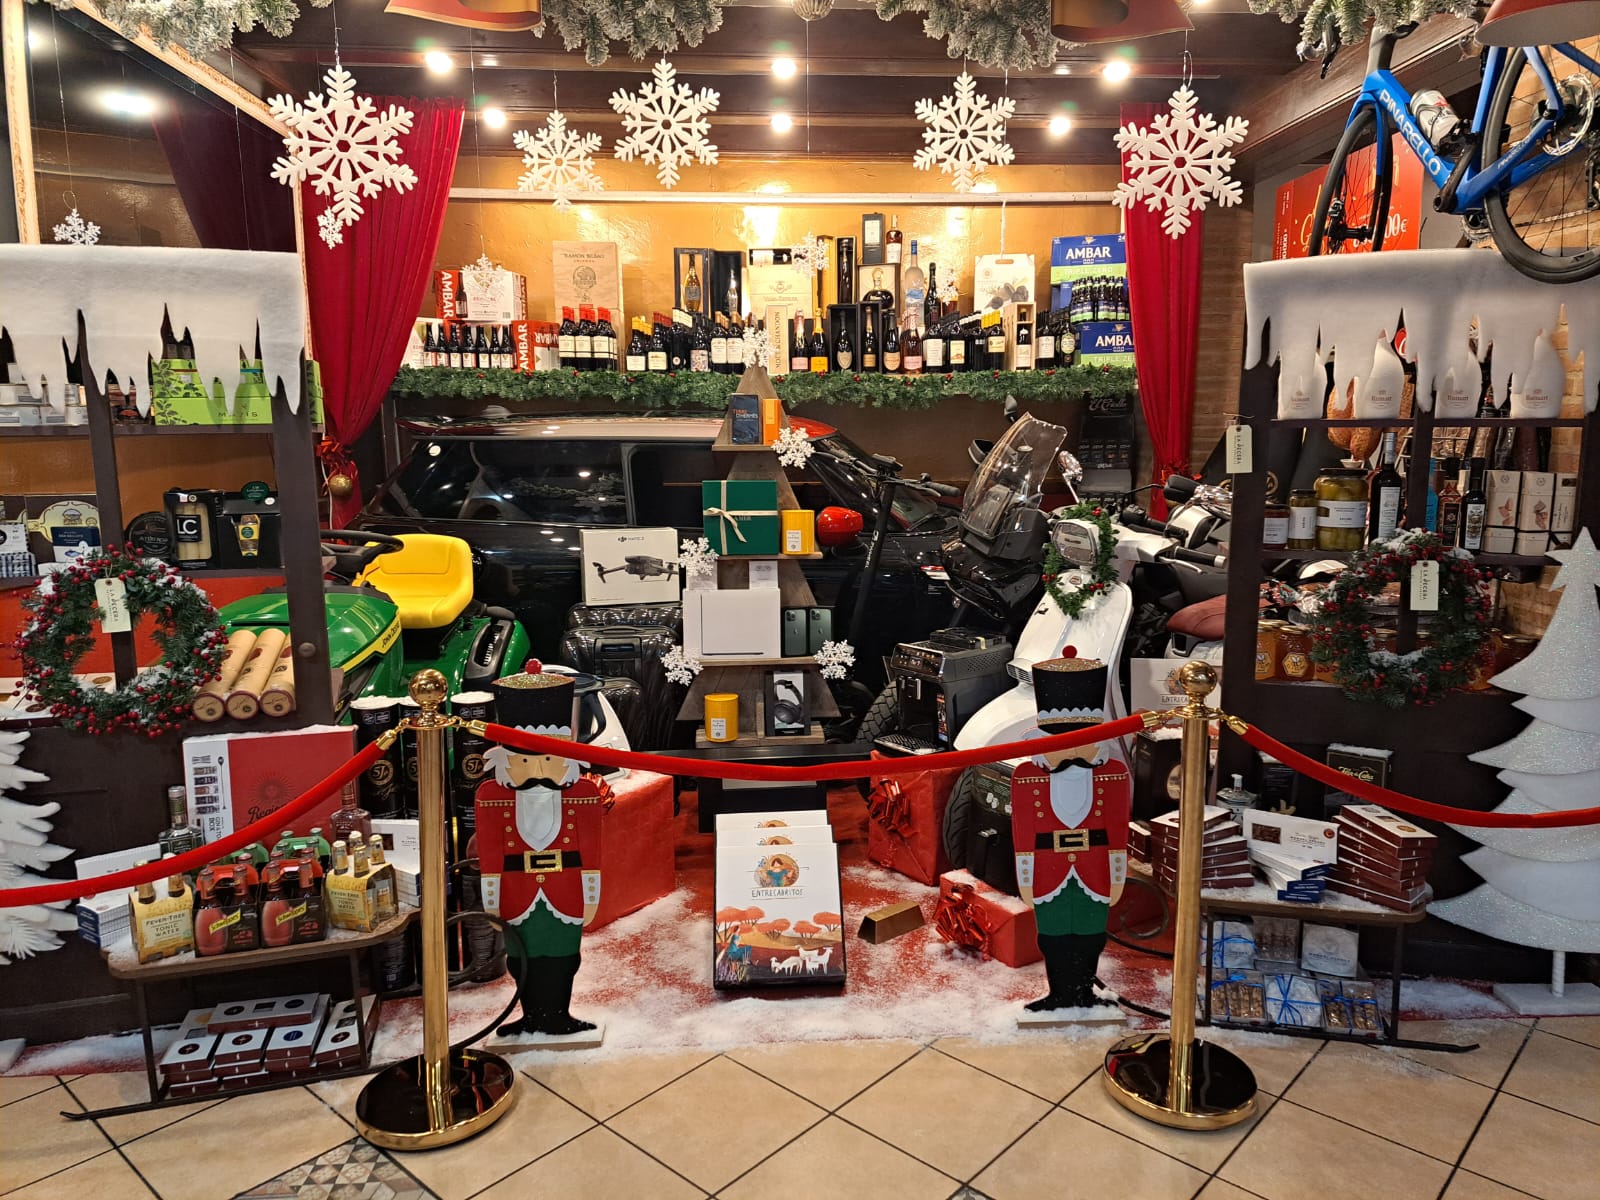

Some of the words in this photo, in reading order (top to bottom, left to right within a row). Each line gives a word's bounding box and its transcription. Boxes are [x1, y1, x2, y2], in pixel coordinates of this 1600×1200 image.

[1379, 89, 1441, 175] PINARELLO
[1065, 246, 1112, 260] AMBAR
[441, 271, 454, 318] AMBAR
[517, 323, 528, 371] AMBAR
[1095, 335, 1134, 347] AMBA
[176, 518, 197, 534] LC
[752, 888, 803, 898] ENTRECABRITOS
[145, 912, 185, 926] FEVER-TREE
[155, 923, 178, 932] TONIC
[155, 928, 180, 937] WATER
